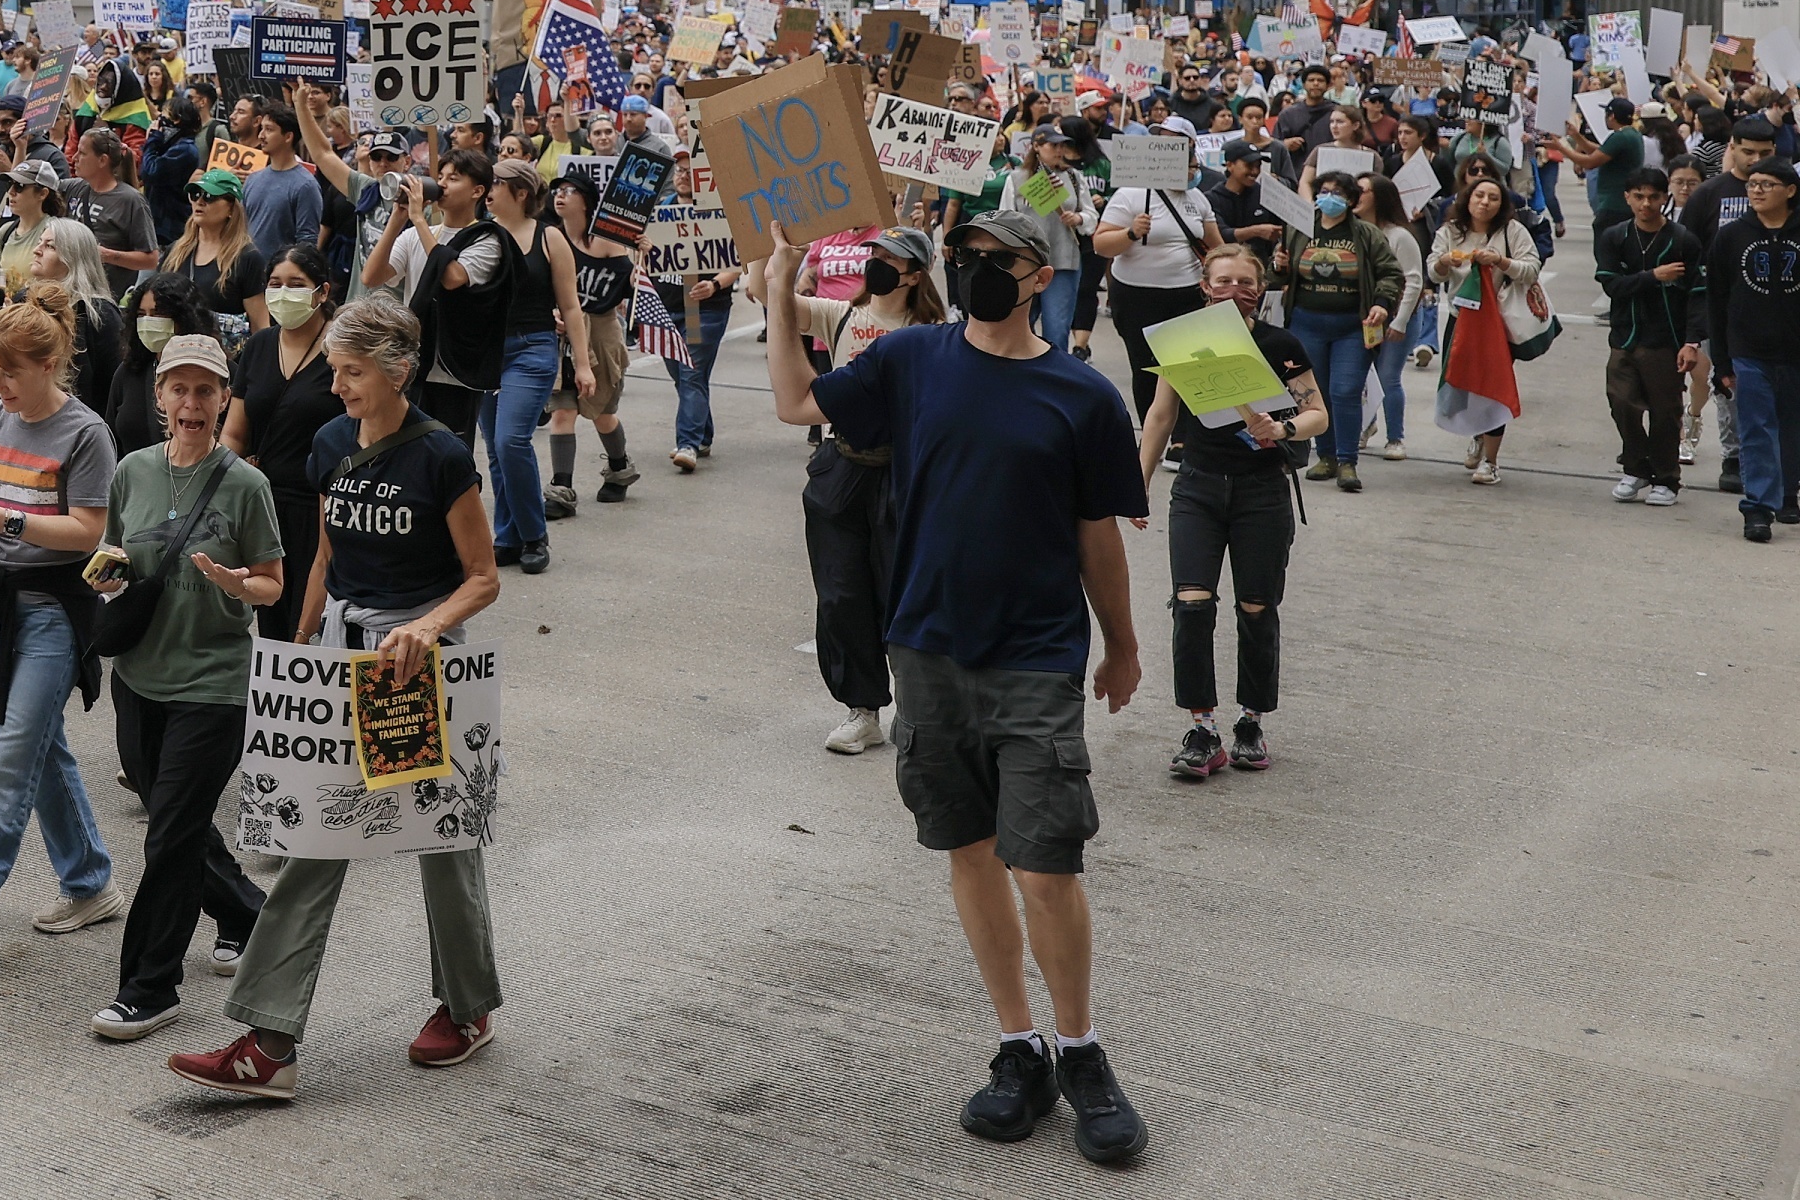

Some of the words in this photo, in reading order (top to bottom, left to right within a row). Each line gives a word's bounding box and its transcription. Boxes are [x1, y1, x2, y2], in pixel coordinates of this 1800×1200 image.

[102, 2, 112, 10] MY
[113, 2, 127, 11] FEET
[128, 2, 145, 10] THAN
[321, 0, 337, 8] your
[103, 14, 116, 22] LIVE
[126, 15, 136, 23] MY
[135, 15, 153, 23] KNEES
[201, 30, 230, 40] CHILDREN
[267, 23, 332, 40] UNWILLING
[261, 38, 336, 55] PARTICIPANT
[372, 20, 480, 62] ICE
[40, 57, 58, 69] WHEN
[188, 45, 208, 67] ICE
[37, 64, 64, 79] INJUSTICE
[260, 63, 273, 74] OF
[273, 64, 286, 74] AN
[287, 64, 336, 78] IDIOCRACY
[1467, 59, 1486, 69] THE
[1488, 62, 1512, 77] ONLY
[33, 75, 60, 90] BECOMES
[374, 65, 477, 102] OUT
[1036, 71, 1074, 93] ICE
[26, 92, 61, 110] RESISTANCE
[351, 110, 374, 119] NEITH
[876, 98, 945, 130] KAROLINE
[943, 113, 995, 142] LEAVITT
[1460, 107, 1477, 119] NO
[1479, 110, 1510, 125] KINGS
[736, 97, 821, 184] NO
[897, 131, 909, 142] IS
[913, 130, 927, 144] A
[1148, 142, 1186, 151] CANNOT
[878, 143, 939, 174] LIAR
[931, 138, 982, 170] FUGLY
[566, 161, 602, 181] ONE
[618, 153, 665, 193] ICE
[737, 161, 850, 235] TYRANTS
[601, 201, 625, 215] MELTS
[624, 207, 648, 223] UNDER
[657, 207, 687, 222] ONLY
[594, 220, 637, 241] RESISTANC
[676, 222, 689, 237] IS
[694, 223, 703, 237] A
[649, 243, 690, 274] RAG
[694, 237, 742, 270] KING
[823, 260, 867, 277] HIM
[1183, 367, 1263, 400] ICE
[329, 477, 371, 494] GULF
[375, 483, 402, 500] OF
[324, 495, 413, 535] MEXICO
[254, 651, 263, 678] I
[271, 653, 352, 689] LOVE
[251, 689, 333, 725] WHO
[373, 697, 390, 708] WE
[391, 691, 421, 706] STAND
[385, 704, 410, 717] WITH
[371, 713, 425, 730] IMMIGRANT
[378, 725, 420, 740] FAMILIES
[246, 730, 358, 766] ABORT
[331, 786, 368, 801] chicago
[324, 795, 395, 825] abortion
[394, 844, 456, 855] CHICAGOABORTIONFUND.ORG
